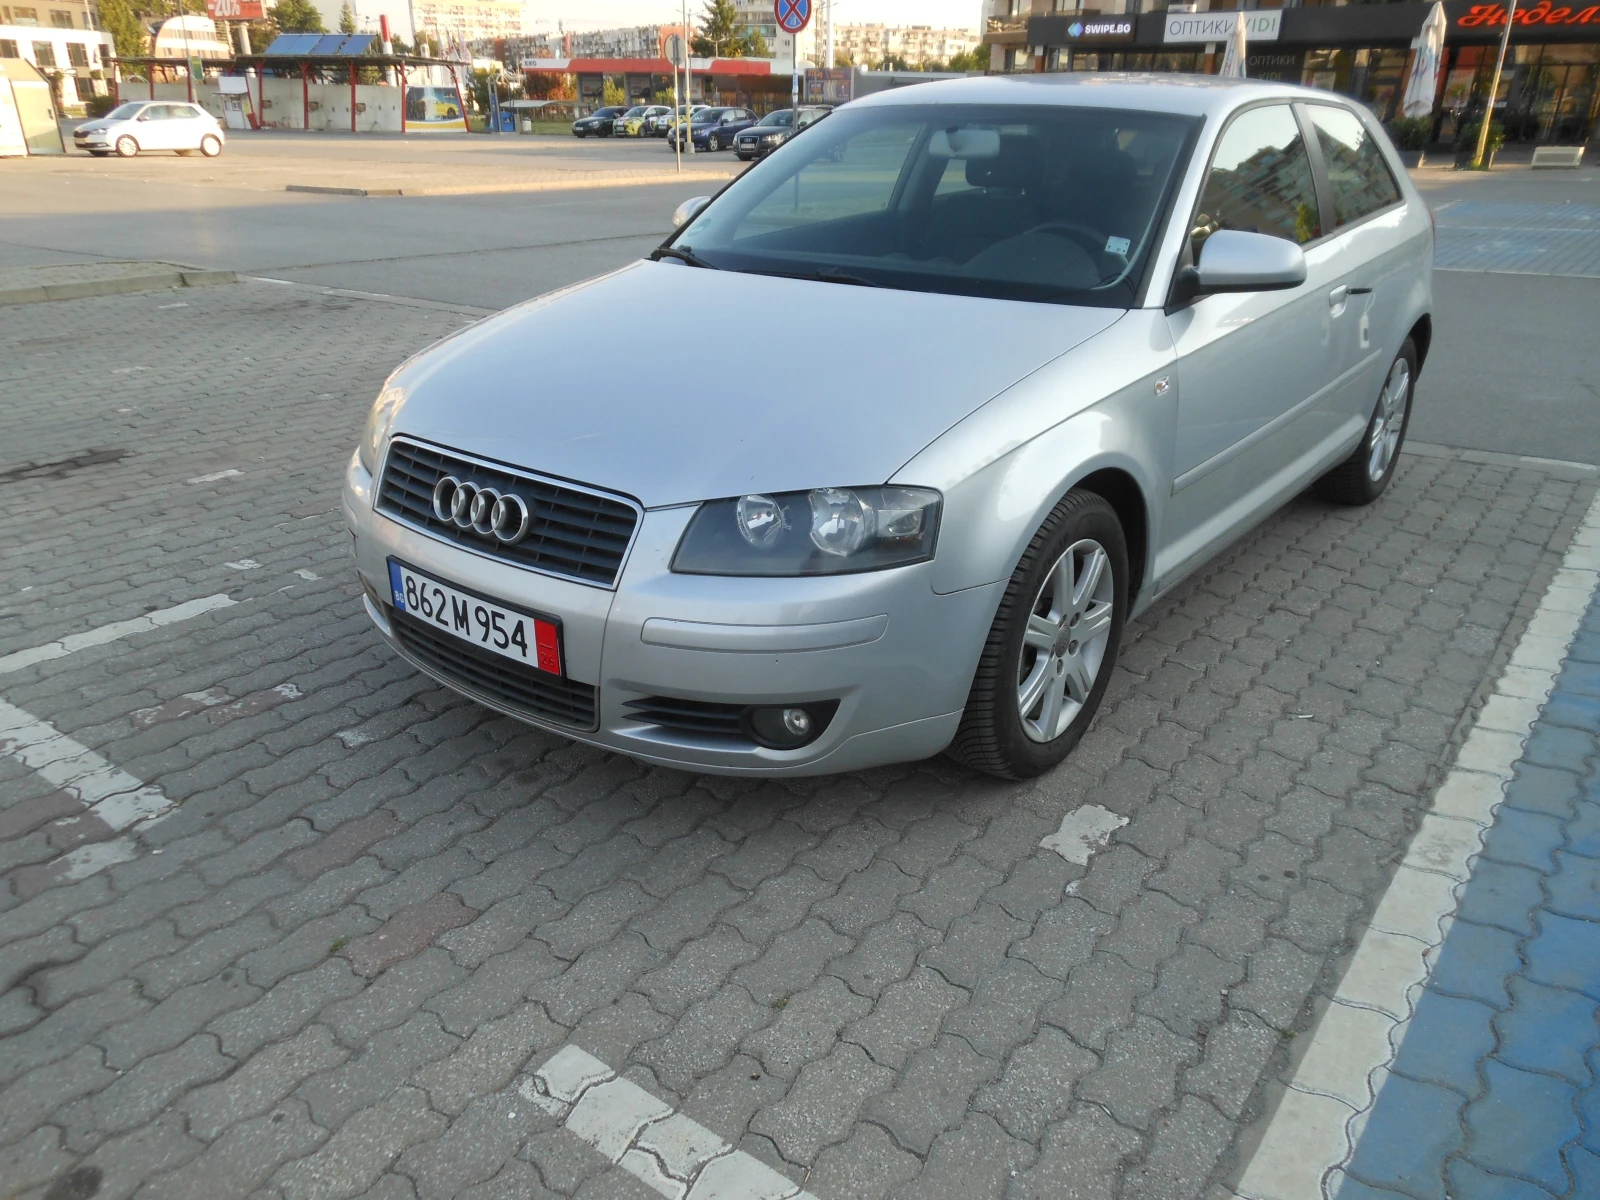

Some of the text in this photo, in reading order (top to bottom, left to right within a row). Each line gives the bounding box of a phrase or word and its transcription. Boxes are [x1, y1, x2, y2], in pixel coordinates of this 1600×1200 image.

[1457, 0, 1600, 26] Недел
[1085, 24, 1131, 34] SWIPE.BG
[1249, 55, 1295, 66] ОПТИКИ
